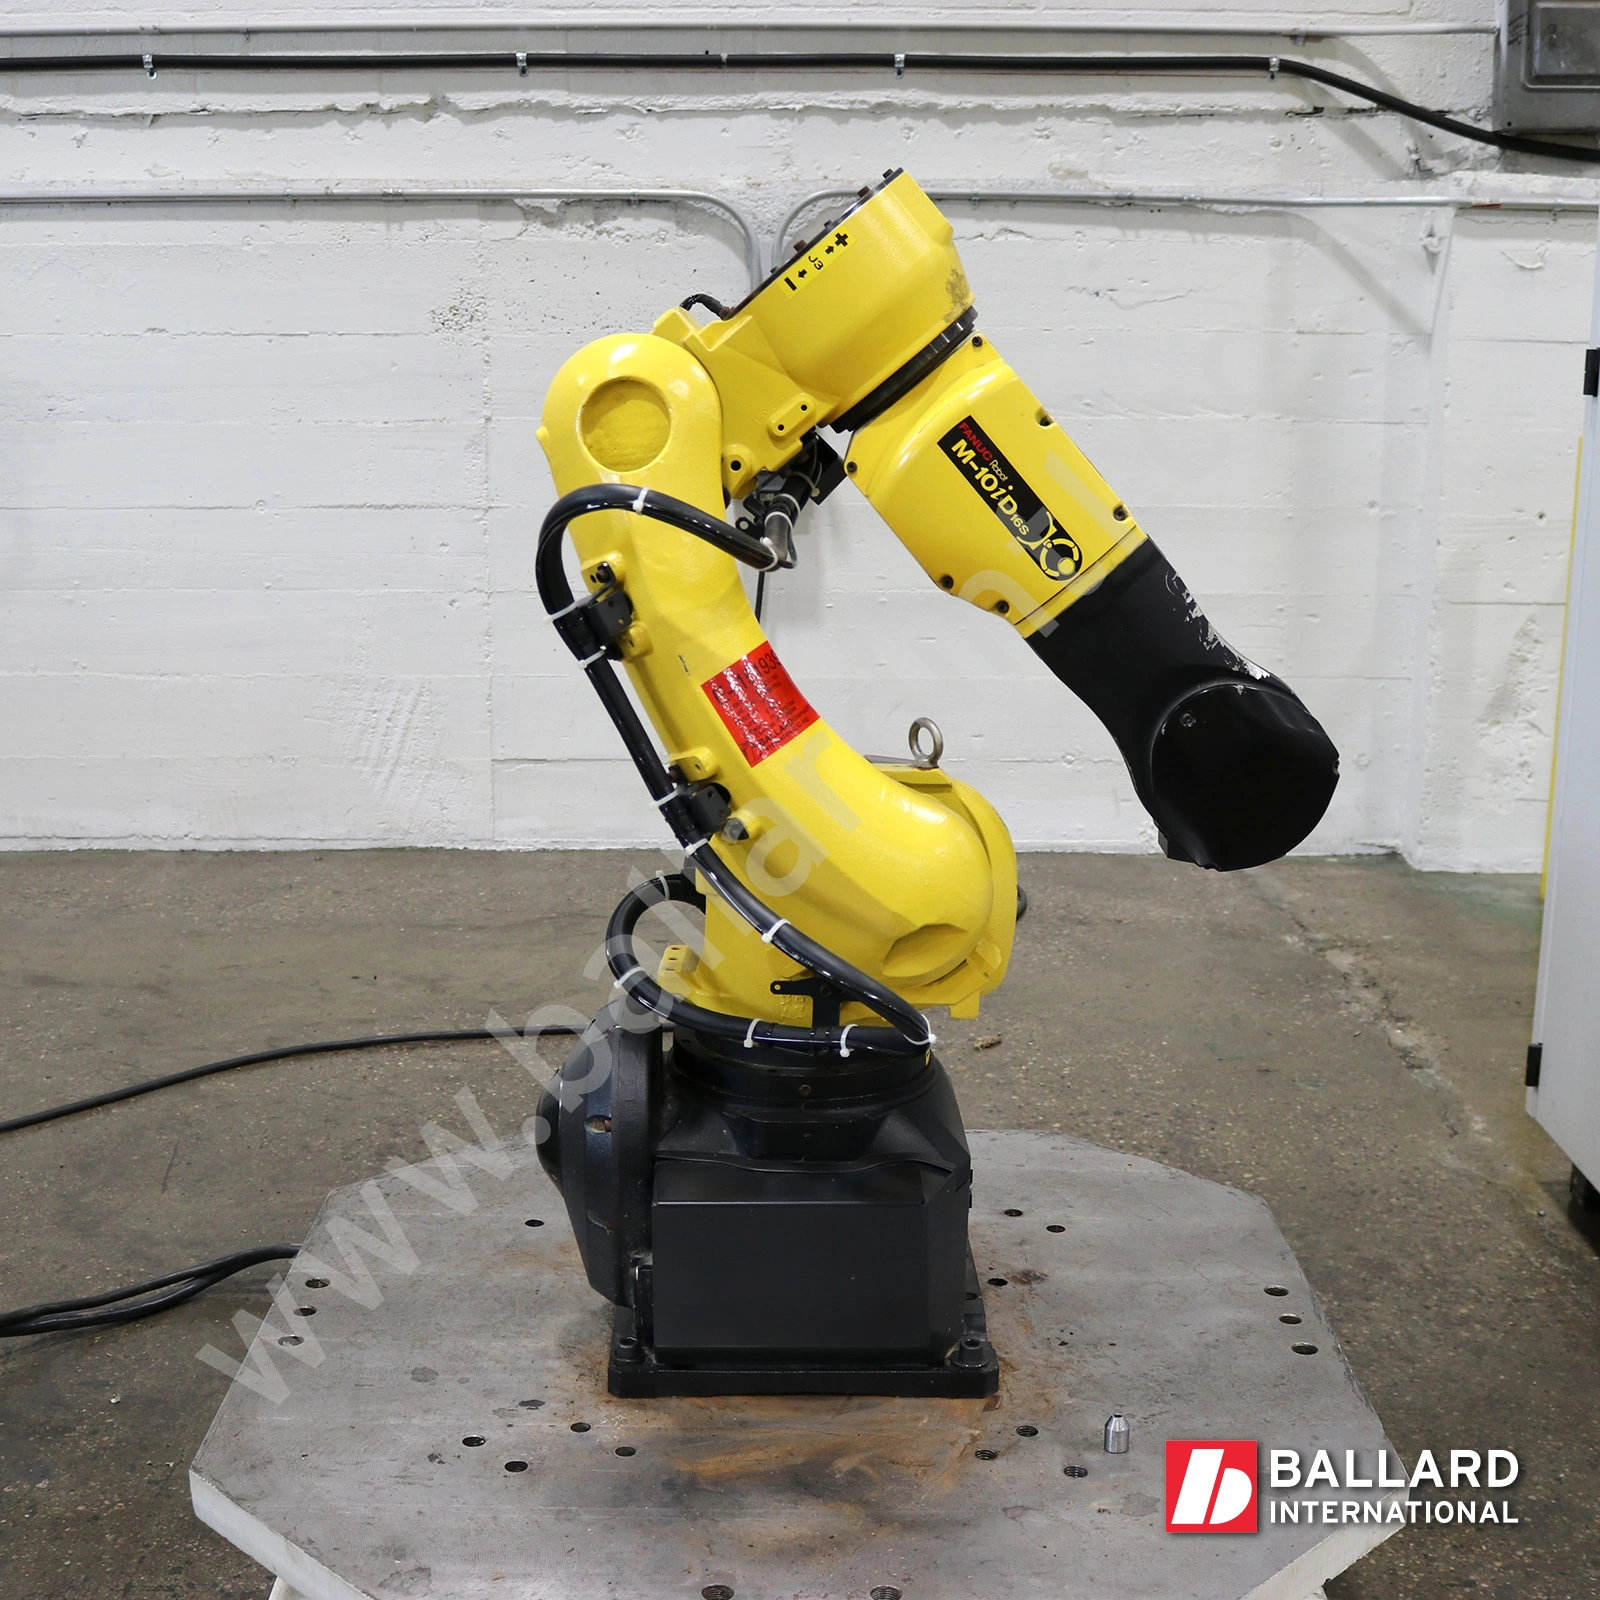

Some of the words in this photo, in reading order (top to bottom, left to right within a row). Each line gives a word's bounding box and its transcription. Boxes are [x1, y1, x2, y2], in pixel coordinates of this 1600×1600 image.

[808, 255, 824, 271] J3
[959, 422, 993, 461] FANUC
[989, 459, 1009, 482] Robot
